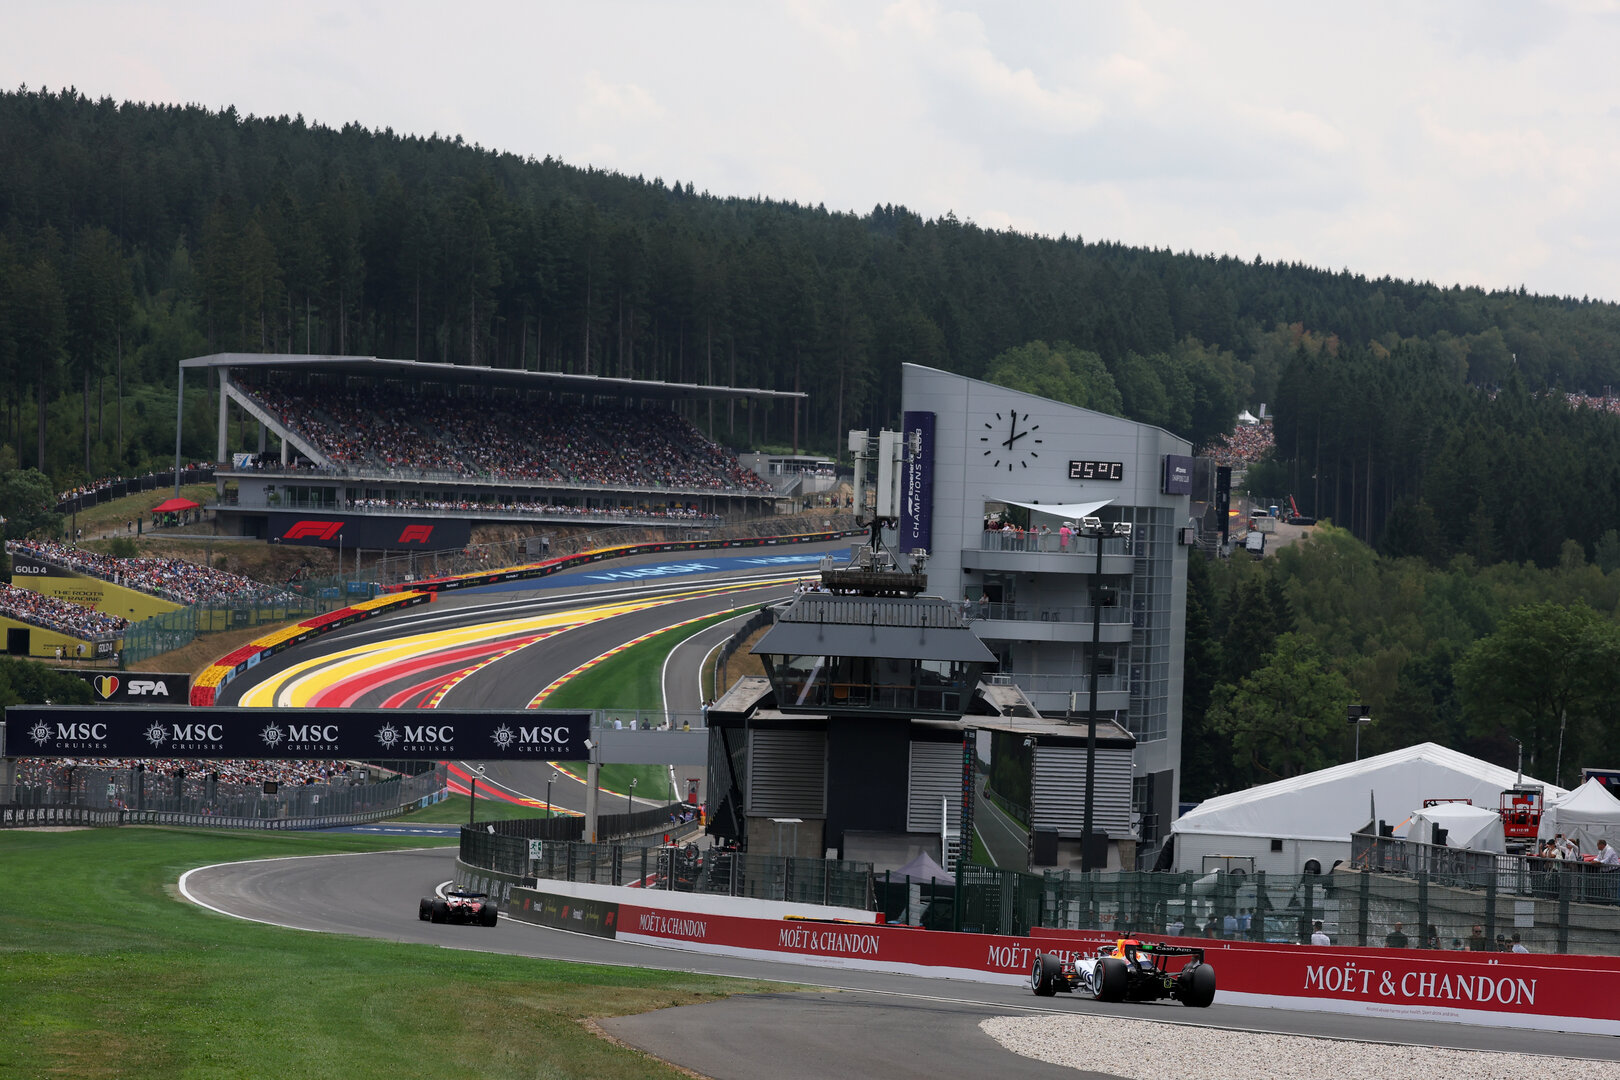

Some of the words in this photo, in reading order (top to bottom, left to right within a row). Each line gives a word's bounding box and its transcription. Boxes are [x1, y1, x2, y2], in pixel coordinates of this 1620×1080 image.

[912, 463, 922, 538] CHAMPIONS
[15, 565, 39, 574] GOLD
[40, 566, 47, 574] 4
[127, 680, 169, 696] SPA
[56, 723, 107, 740] MSC
[172, 723, 223, 741] MSC
[288, 725, 339, 742] MSC
[403, 725, 454, 743] MSC
[518, 726, 570, 744] MSC
[638, 911, 661, 932] MOËT
[660, 916, 667, 933] &
[667, 917, 707, 938] CHANDON
[778, 925, 810, 949] MOËT
[810, 931, 819, 950] &
[820, 932, 880, 954] CHANDON
[986, 942, 1032, 969] MOËT
[1303, 961, 1376, 995] MOËT
[1378, 970, 1396, 997] &
[1400, 972, 1537, 1006] CHANDON
